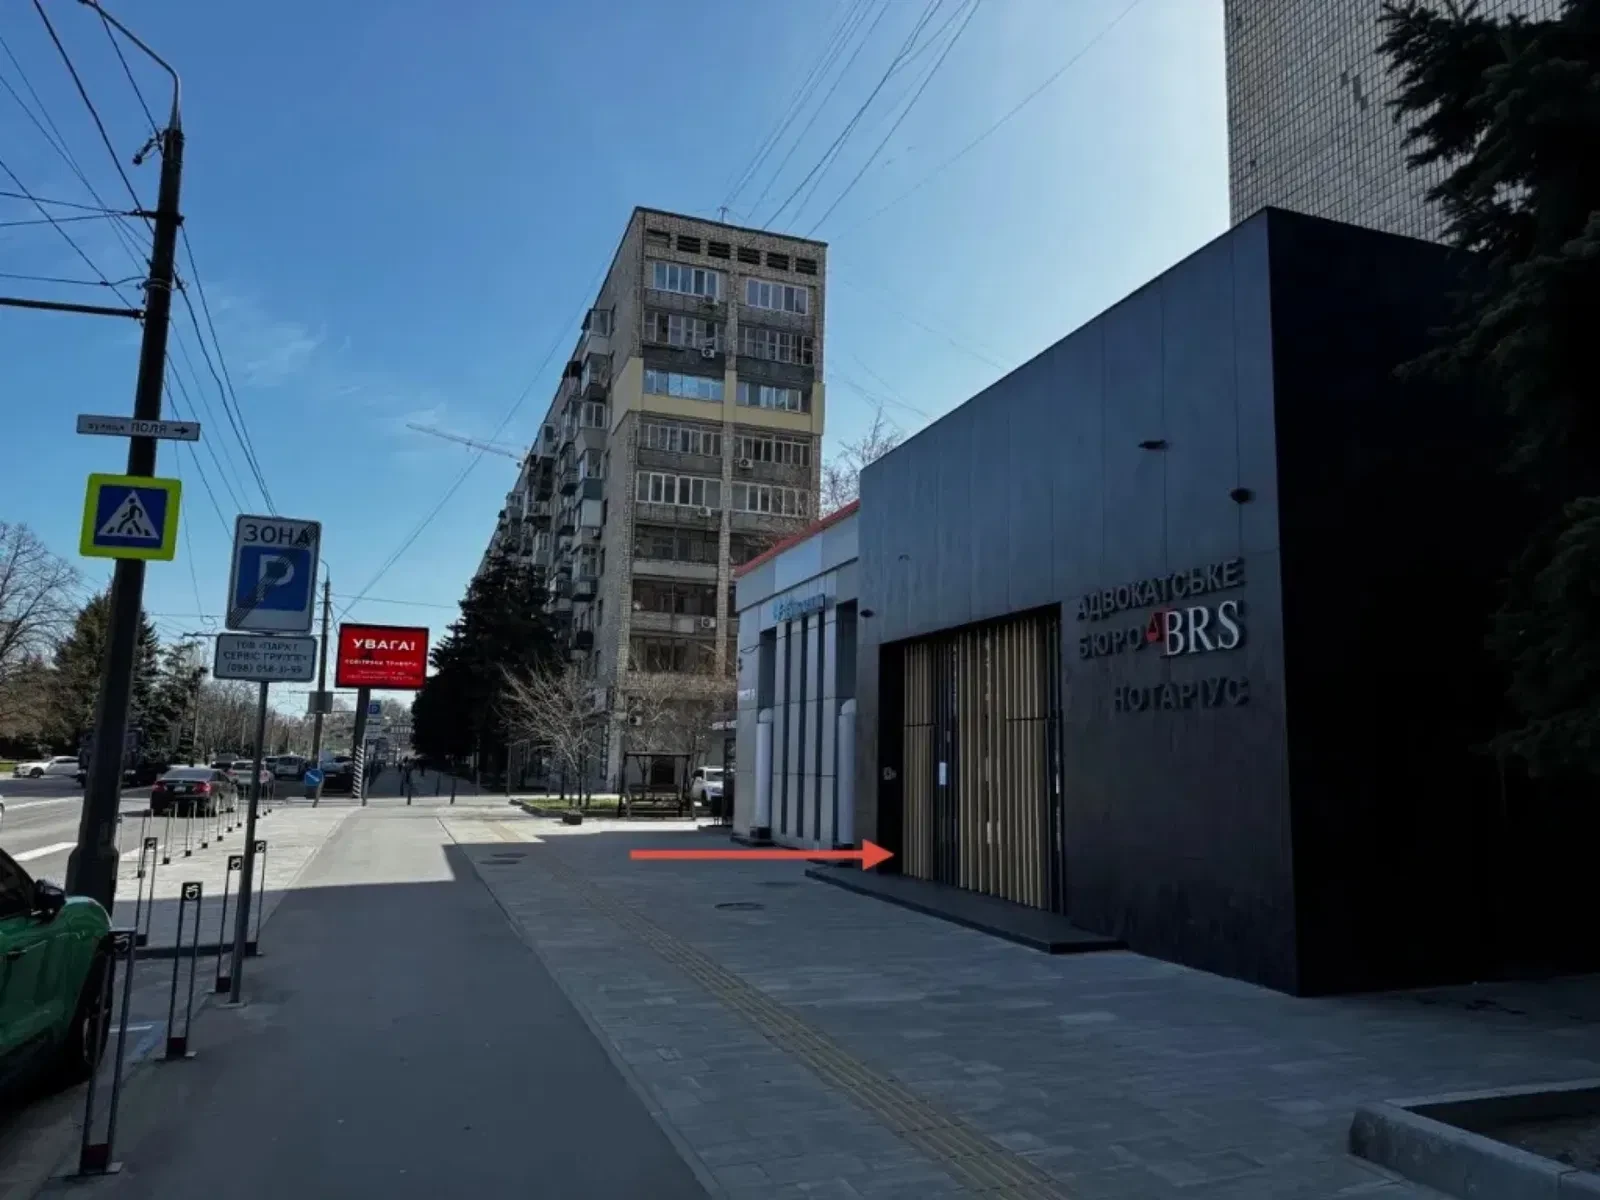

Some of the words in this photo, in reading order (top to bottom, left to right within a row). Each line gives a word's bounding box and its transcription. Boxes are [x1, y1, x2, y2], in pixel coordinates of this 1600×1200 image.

[131, 422, 168, 436] ПОЛЯ
[244, 524, 311, 547] ЗОНА
[1077, 557, 1244, 621] АДВОКАТСЬКЕ
[353, 638, 416, 651] УВАГА!
[1079, 625, 1145, 661] БЮРО
[1164, 600, 1240, 656] BRS
[1113, 676, 1249, 712] НОТАРІУС
